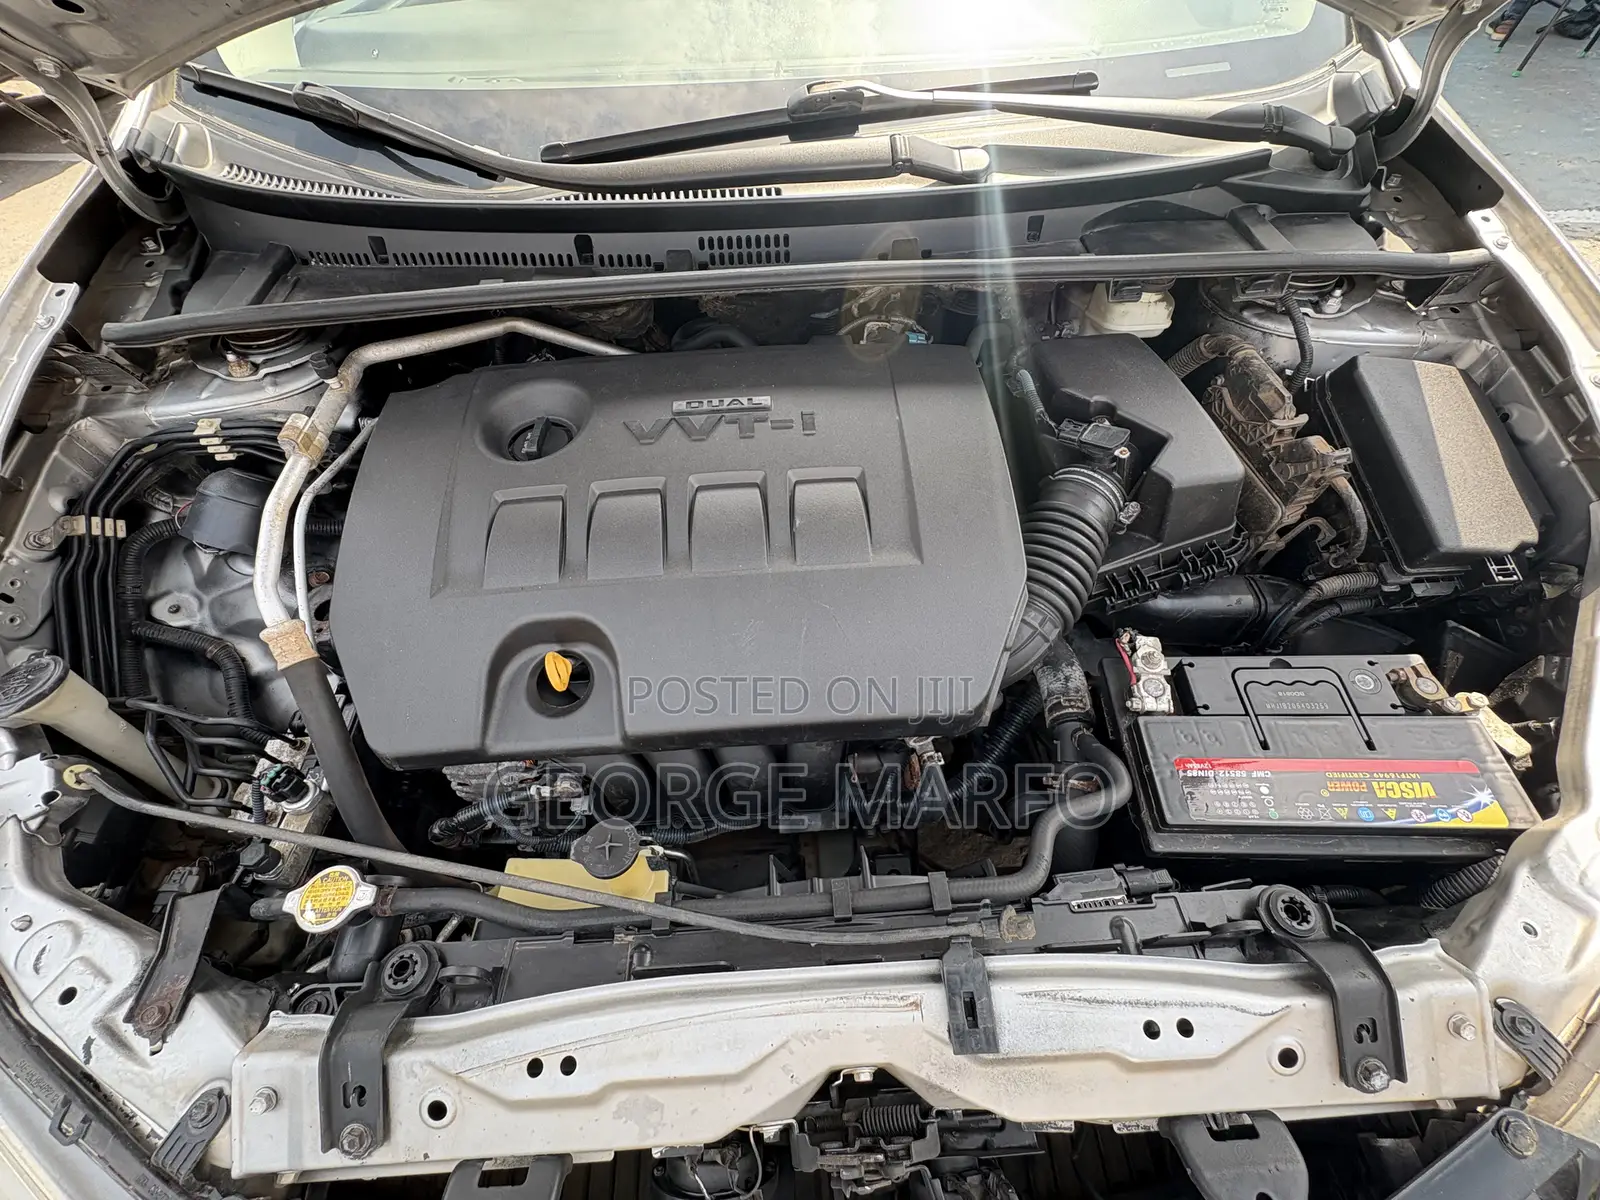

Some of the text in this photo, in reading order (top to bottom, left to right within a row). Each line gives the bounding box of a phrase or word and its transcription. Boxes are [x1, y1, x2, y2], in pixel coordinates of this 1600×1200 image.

[685, 397, 763, 410] DUAL
[1327, 781, 1437, 799] VISCA POWER
